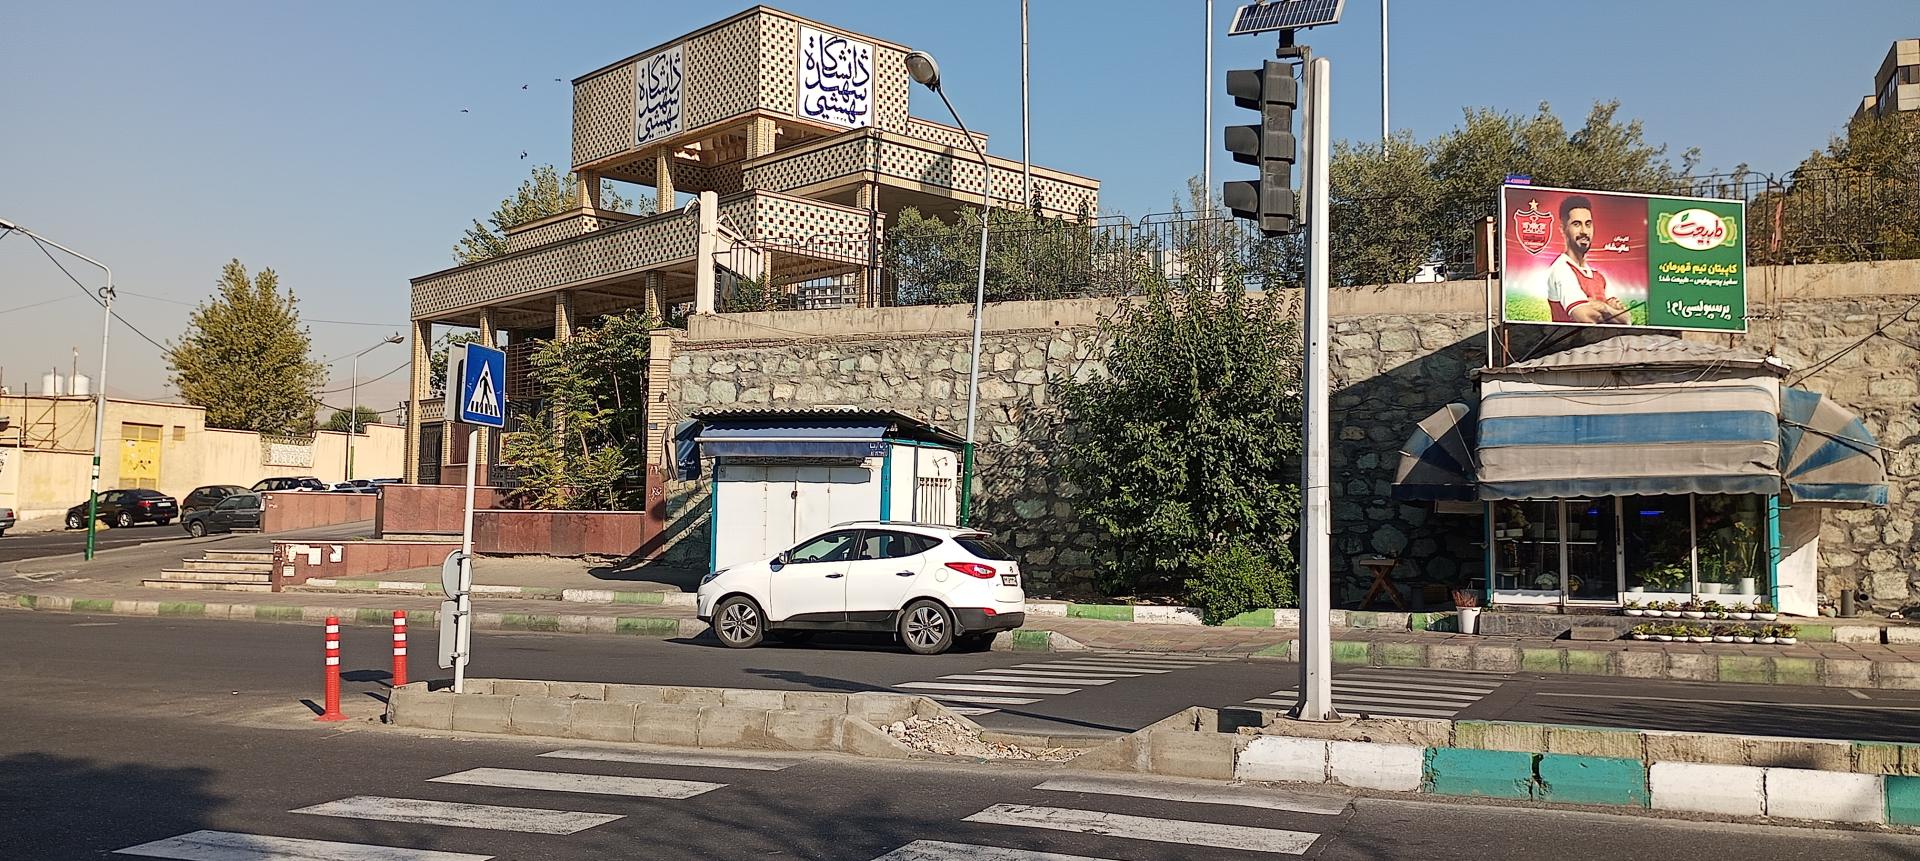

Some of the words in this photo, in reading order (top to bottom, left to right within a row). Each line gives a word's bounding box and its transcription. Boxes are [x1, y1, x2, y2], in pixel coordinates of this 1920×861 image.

[804, 33, 870, 87] دانشگاه
[638, 52, 682, 101] دانشگاه
[804, 91, 868, 125] بهشتی
[637, 105, 680, 142] بهشتی
[1672, 219, 1723, 244] طبیعت
[1691, 264, 1707, 274] تیم
[1693, 277, 1723, 287] پرسپولیس
[1707, 264, 1738, 277] کاپیتان
